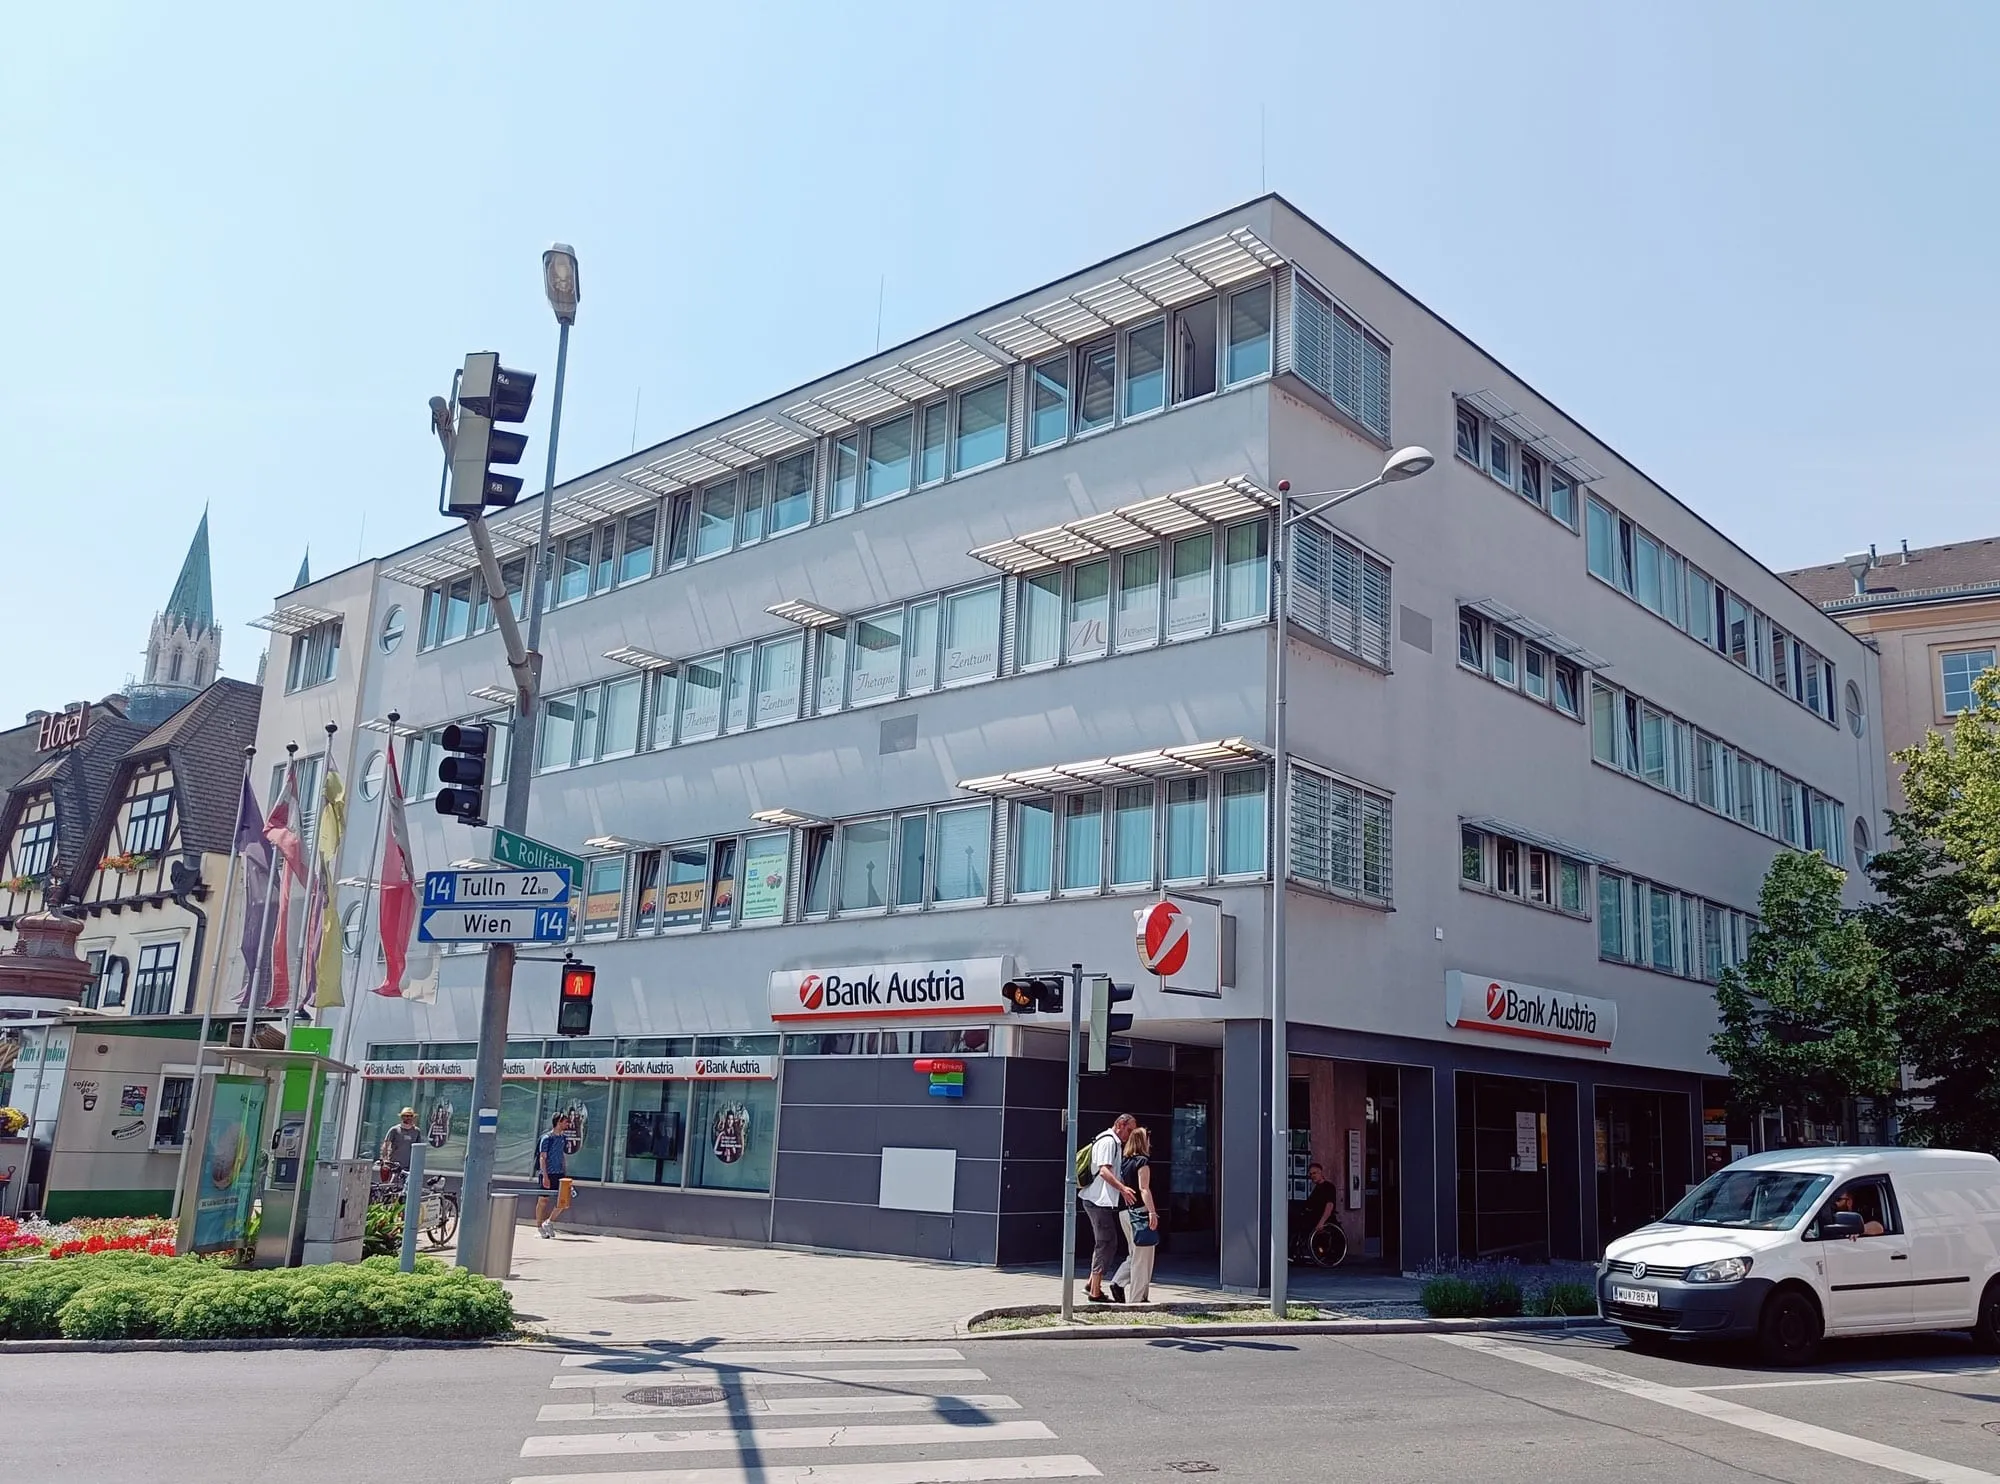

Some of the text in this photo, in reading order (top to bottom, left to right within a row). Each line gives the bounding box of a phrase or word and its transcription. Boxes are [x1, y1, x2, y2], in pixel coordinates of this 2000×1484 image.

[855, 651, 992, 692] Therapie im Zentrum
[684, 712, 717, 729] Therapie
[760, 695, 795, 712] Zentrum
[35, 702, 84, 752] Hotel
[429, 876, 549, 900] 14 Tulln 22 km
[464, 911, 563, 936] Wien 14
[826, 969, 964, 1006] Bank Austria
[1506, 989, 1597, 1034] Bank Austria
[370, 1063, 405, 1075] Bank Austria
[425, 1063, 462, 1075] Bank Austria
[503, 1062, 525, 1075] Austria
[552, 1061, 596, 1074] Bank Austria
[625, 1060, 674, 1074] Bank Austria
[706, 1059, 760, 1074] Bank Austria
[73, 1080, 96, 1089] coffee
